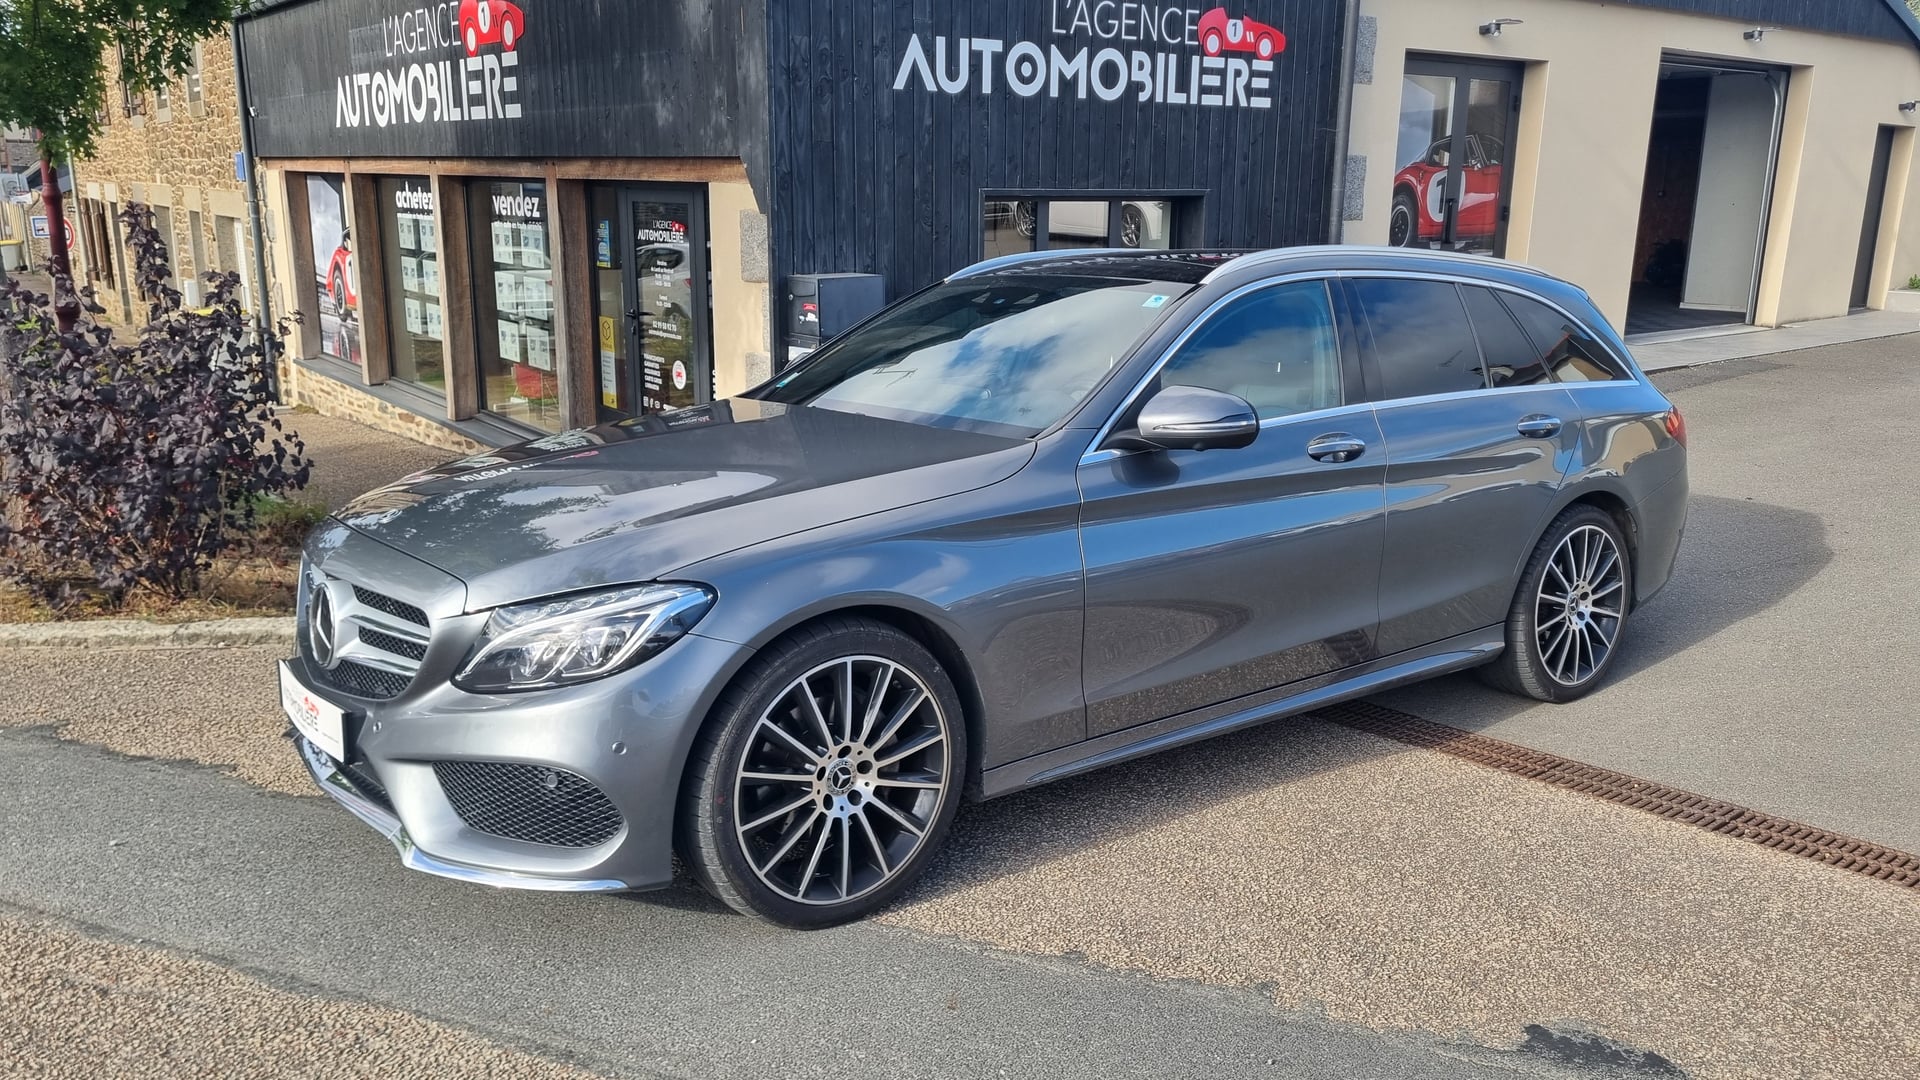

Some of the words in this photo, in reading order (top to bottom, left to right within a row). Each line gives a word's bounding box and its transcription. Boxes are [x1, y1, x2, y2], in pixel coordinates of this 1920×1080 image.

[383, 2, 462, 57] L'AGENCE
[395, 180, 433, 210] achetez
[492, 184, 540, 218] vendez
